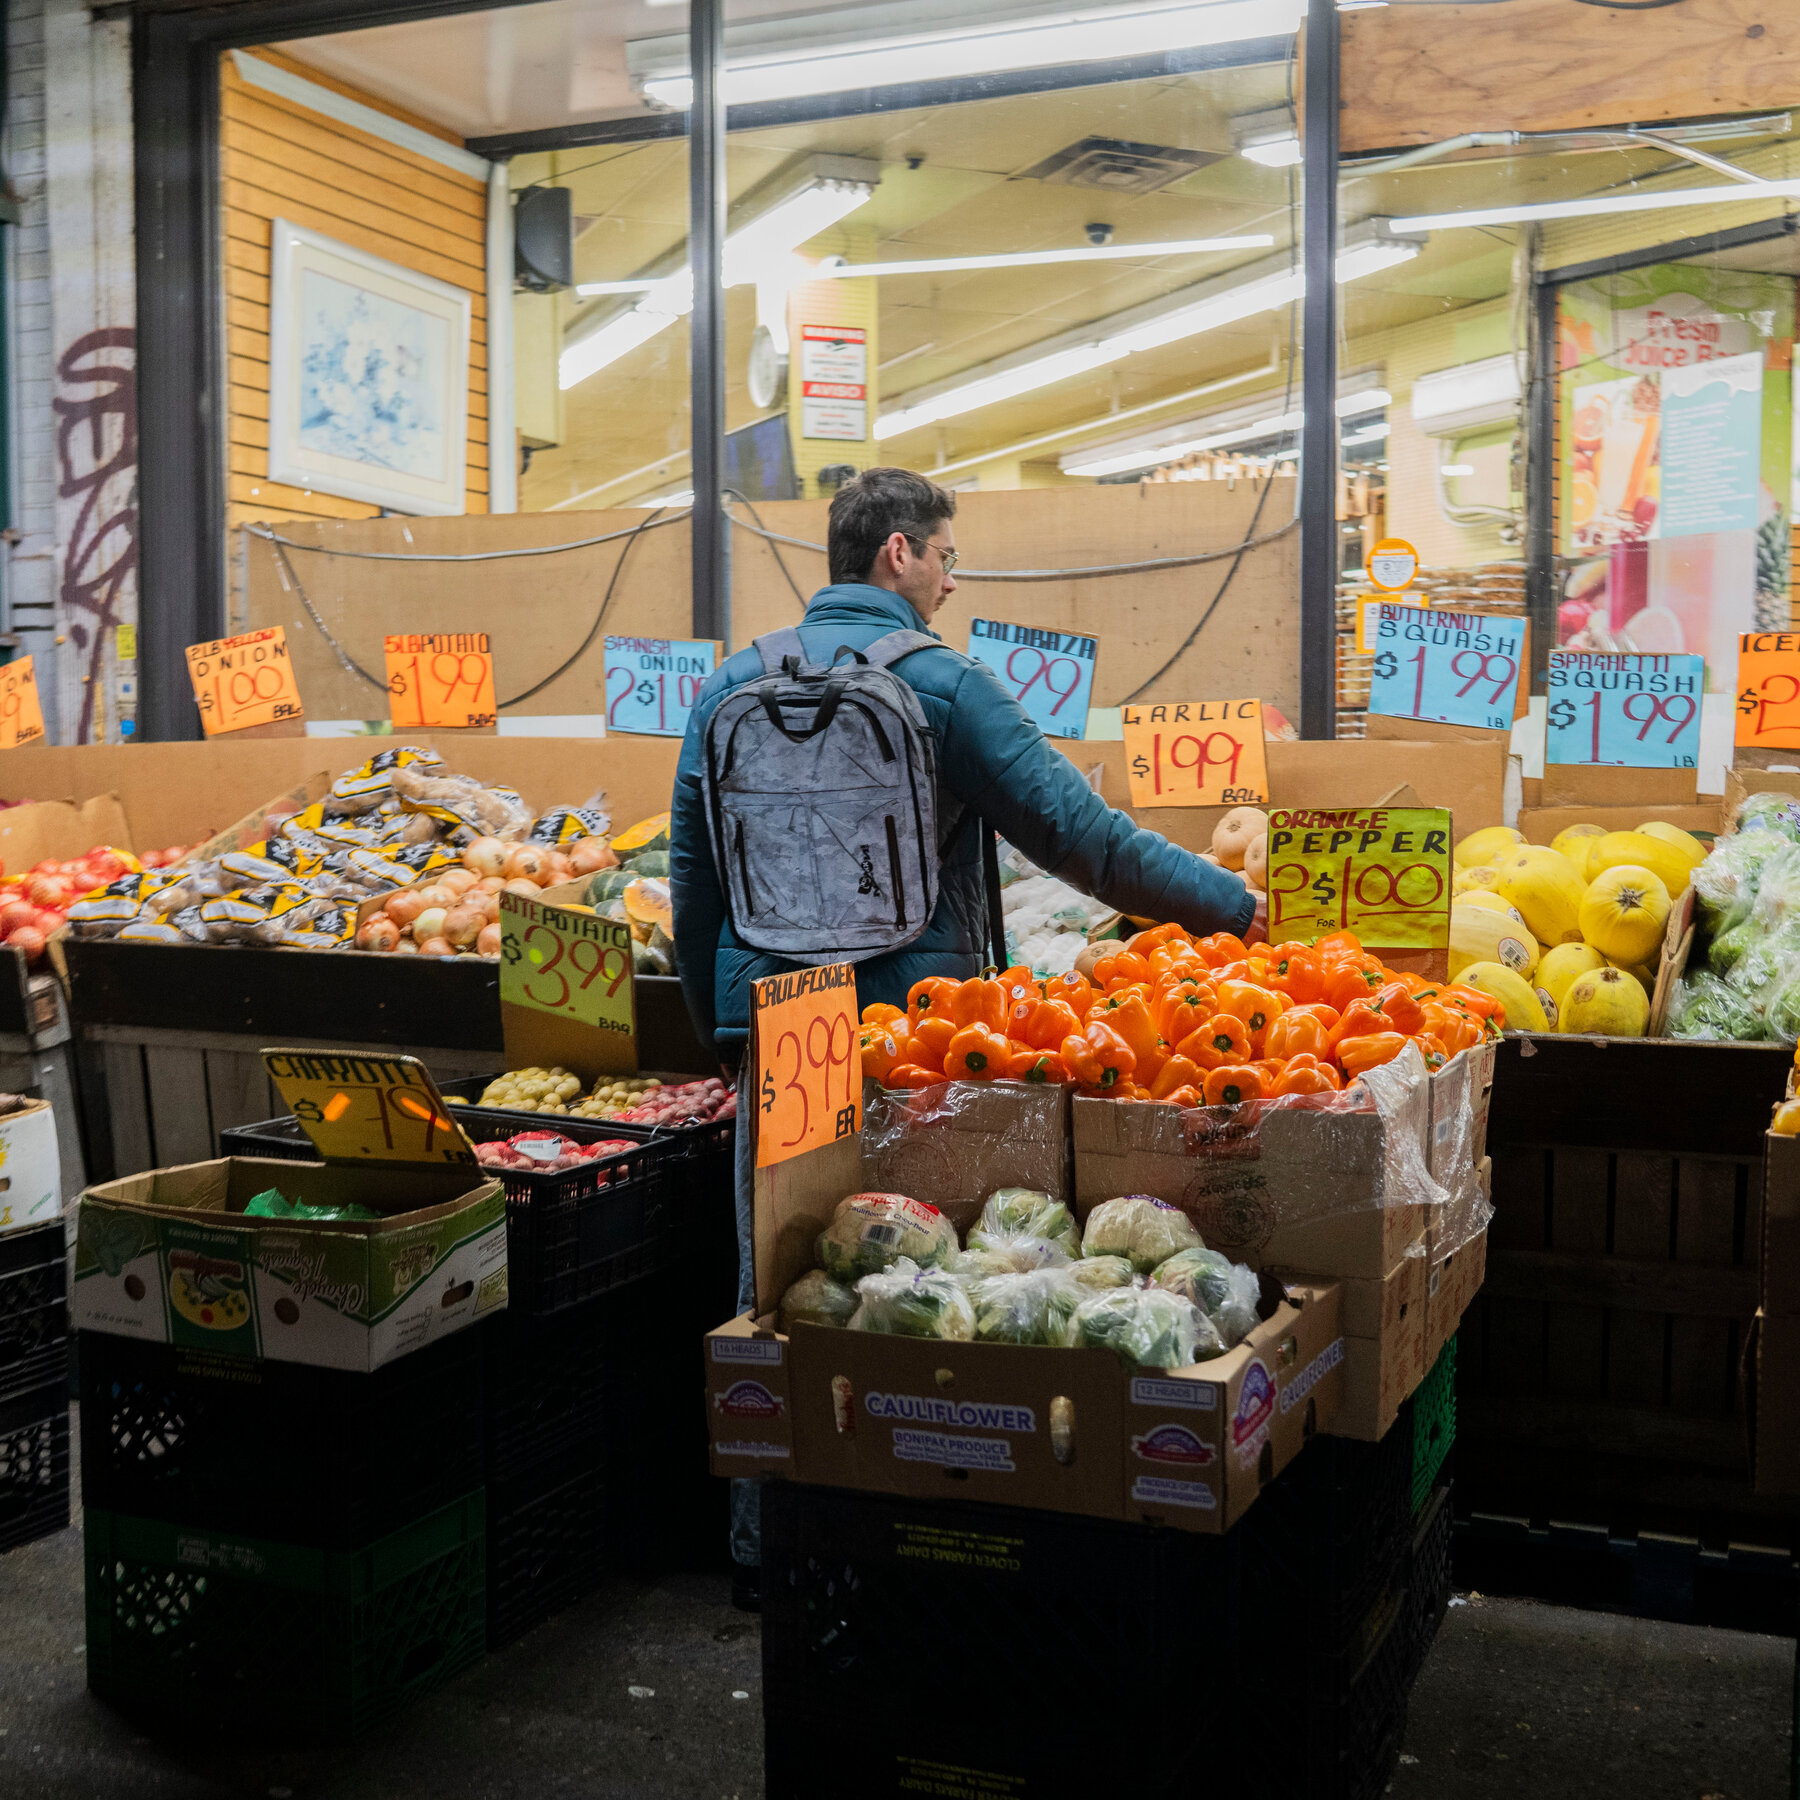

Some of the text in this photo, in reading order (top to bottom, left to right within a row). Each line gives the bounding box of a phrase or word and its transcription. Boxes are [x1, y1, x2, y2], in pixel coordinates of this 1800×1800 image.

[1626, 338, 1688, 367] Juice
[807, 384, 861, 397] AVISO
[1380, 604, 1487, 633] BUTTERNUT
[223, 628, 276, 649] YELLOW
[421, 632, 490, 653] POTATO
[604, 636, 671, 655] SPANISH
[970, 618, 1097, 660] CALABAZA
[1378, 620, 1516, 656] SQUASH
[196, 640, 287, 677] ONION
[640, 654, 706, 674] ONION
[1550, 654, 1670, 673] SPAGHETTI
[1549, 670, 1695, 693] SQUASH
[1063, 726, 1080, 739] LB
[1488, 716, 1505, 728] LB
[1673, 756, 1695, 768] LB
[1269, 810, 1389, 830] ORANGE
[1271, 830, 1447, 854] PEPPER
[541, 907, 629, 949] POTATO
[1316, 918, 1336, 928] FOR
[757, 963, 856, 1012] CAULIFLOWER
[265, 1055, 422, 1085] CHAYOTE
[867, 1396, 1033, 1431] CAULIFLOWER
[948, 1439, 1008, 1455] PRODUCE
[896, 1543, 1021, 1571] CLOVER FARMS DAIRY
